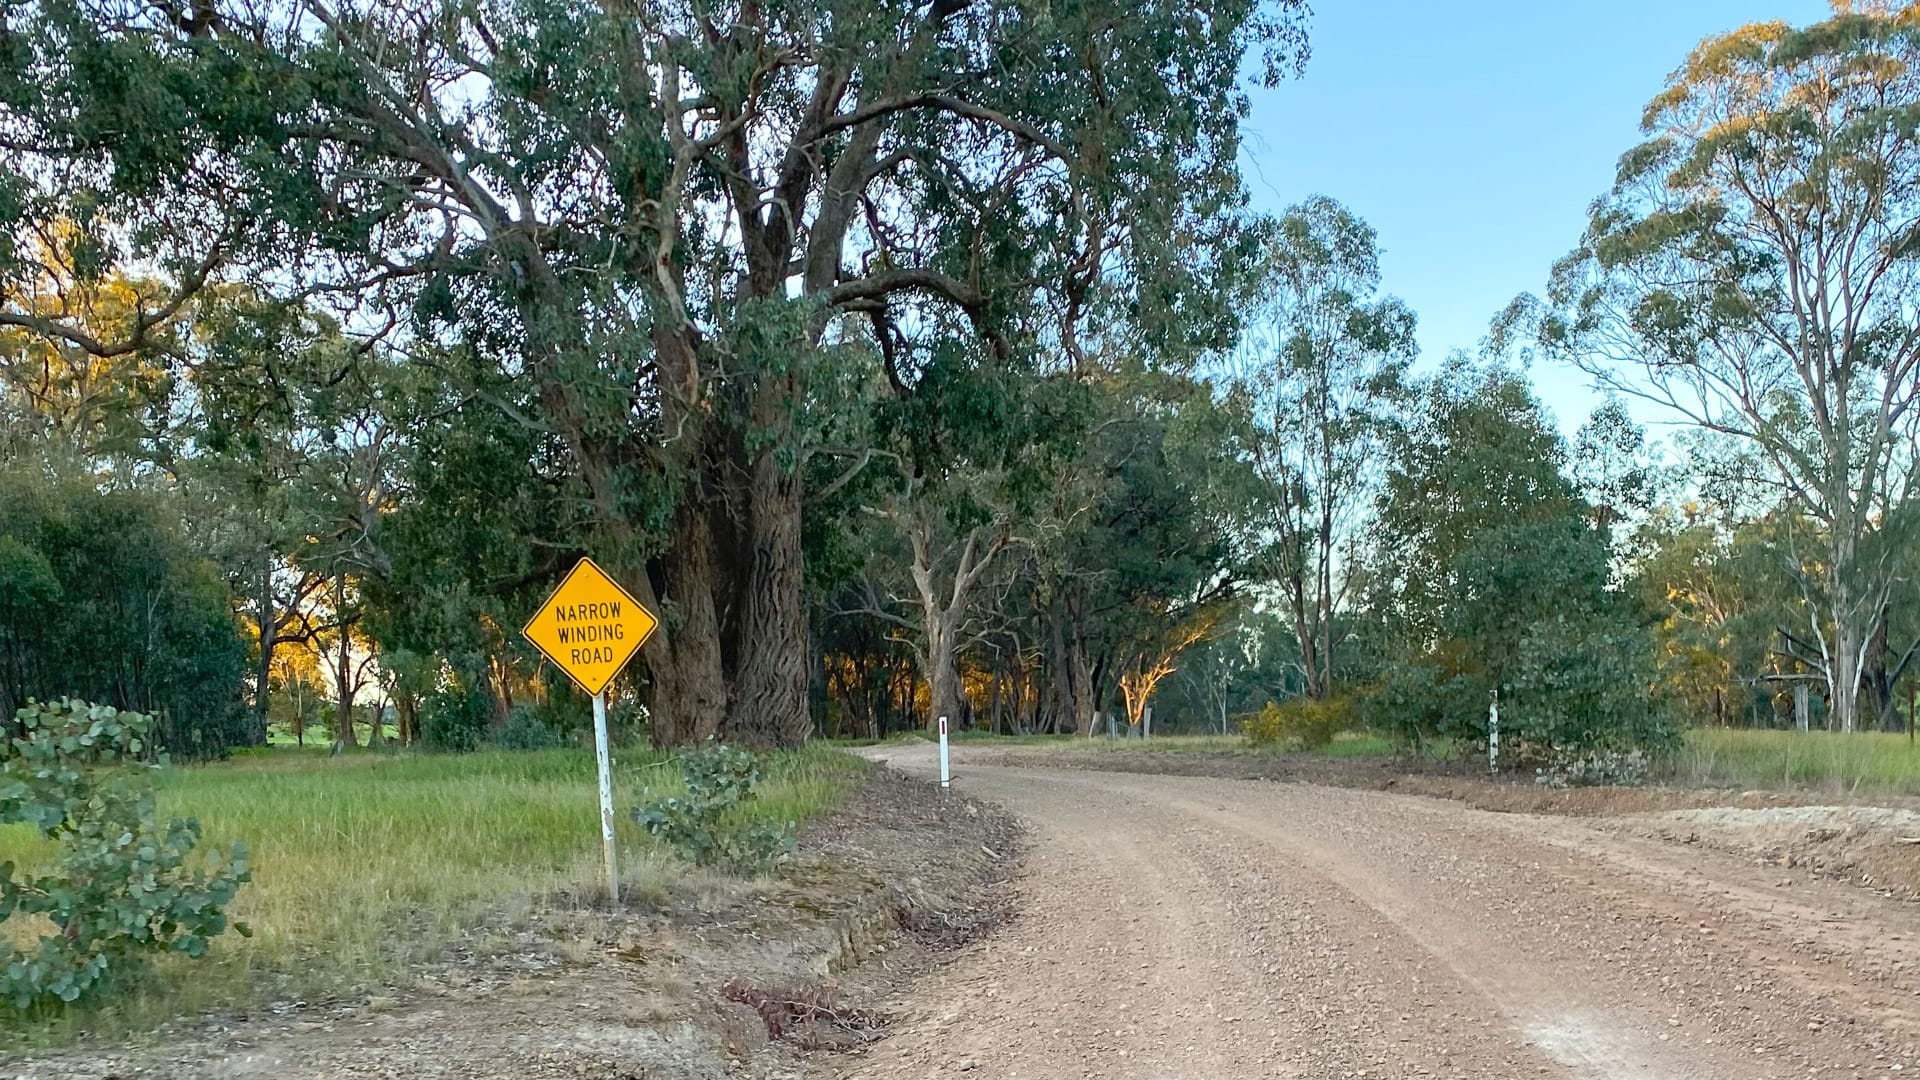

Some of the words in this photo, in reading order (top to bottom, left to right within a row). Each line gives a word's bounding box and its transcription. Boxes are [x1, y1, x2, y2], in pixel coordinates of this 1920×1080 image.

[556, 602, 620, 622] NARROW
[558, 624, 624, 643] WINDING
[571, 647, 613, 665] ROAD
